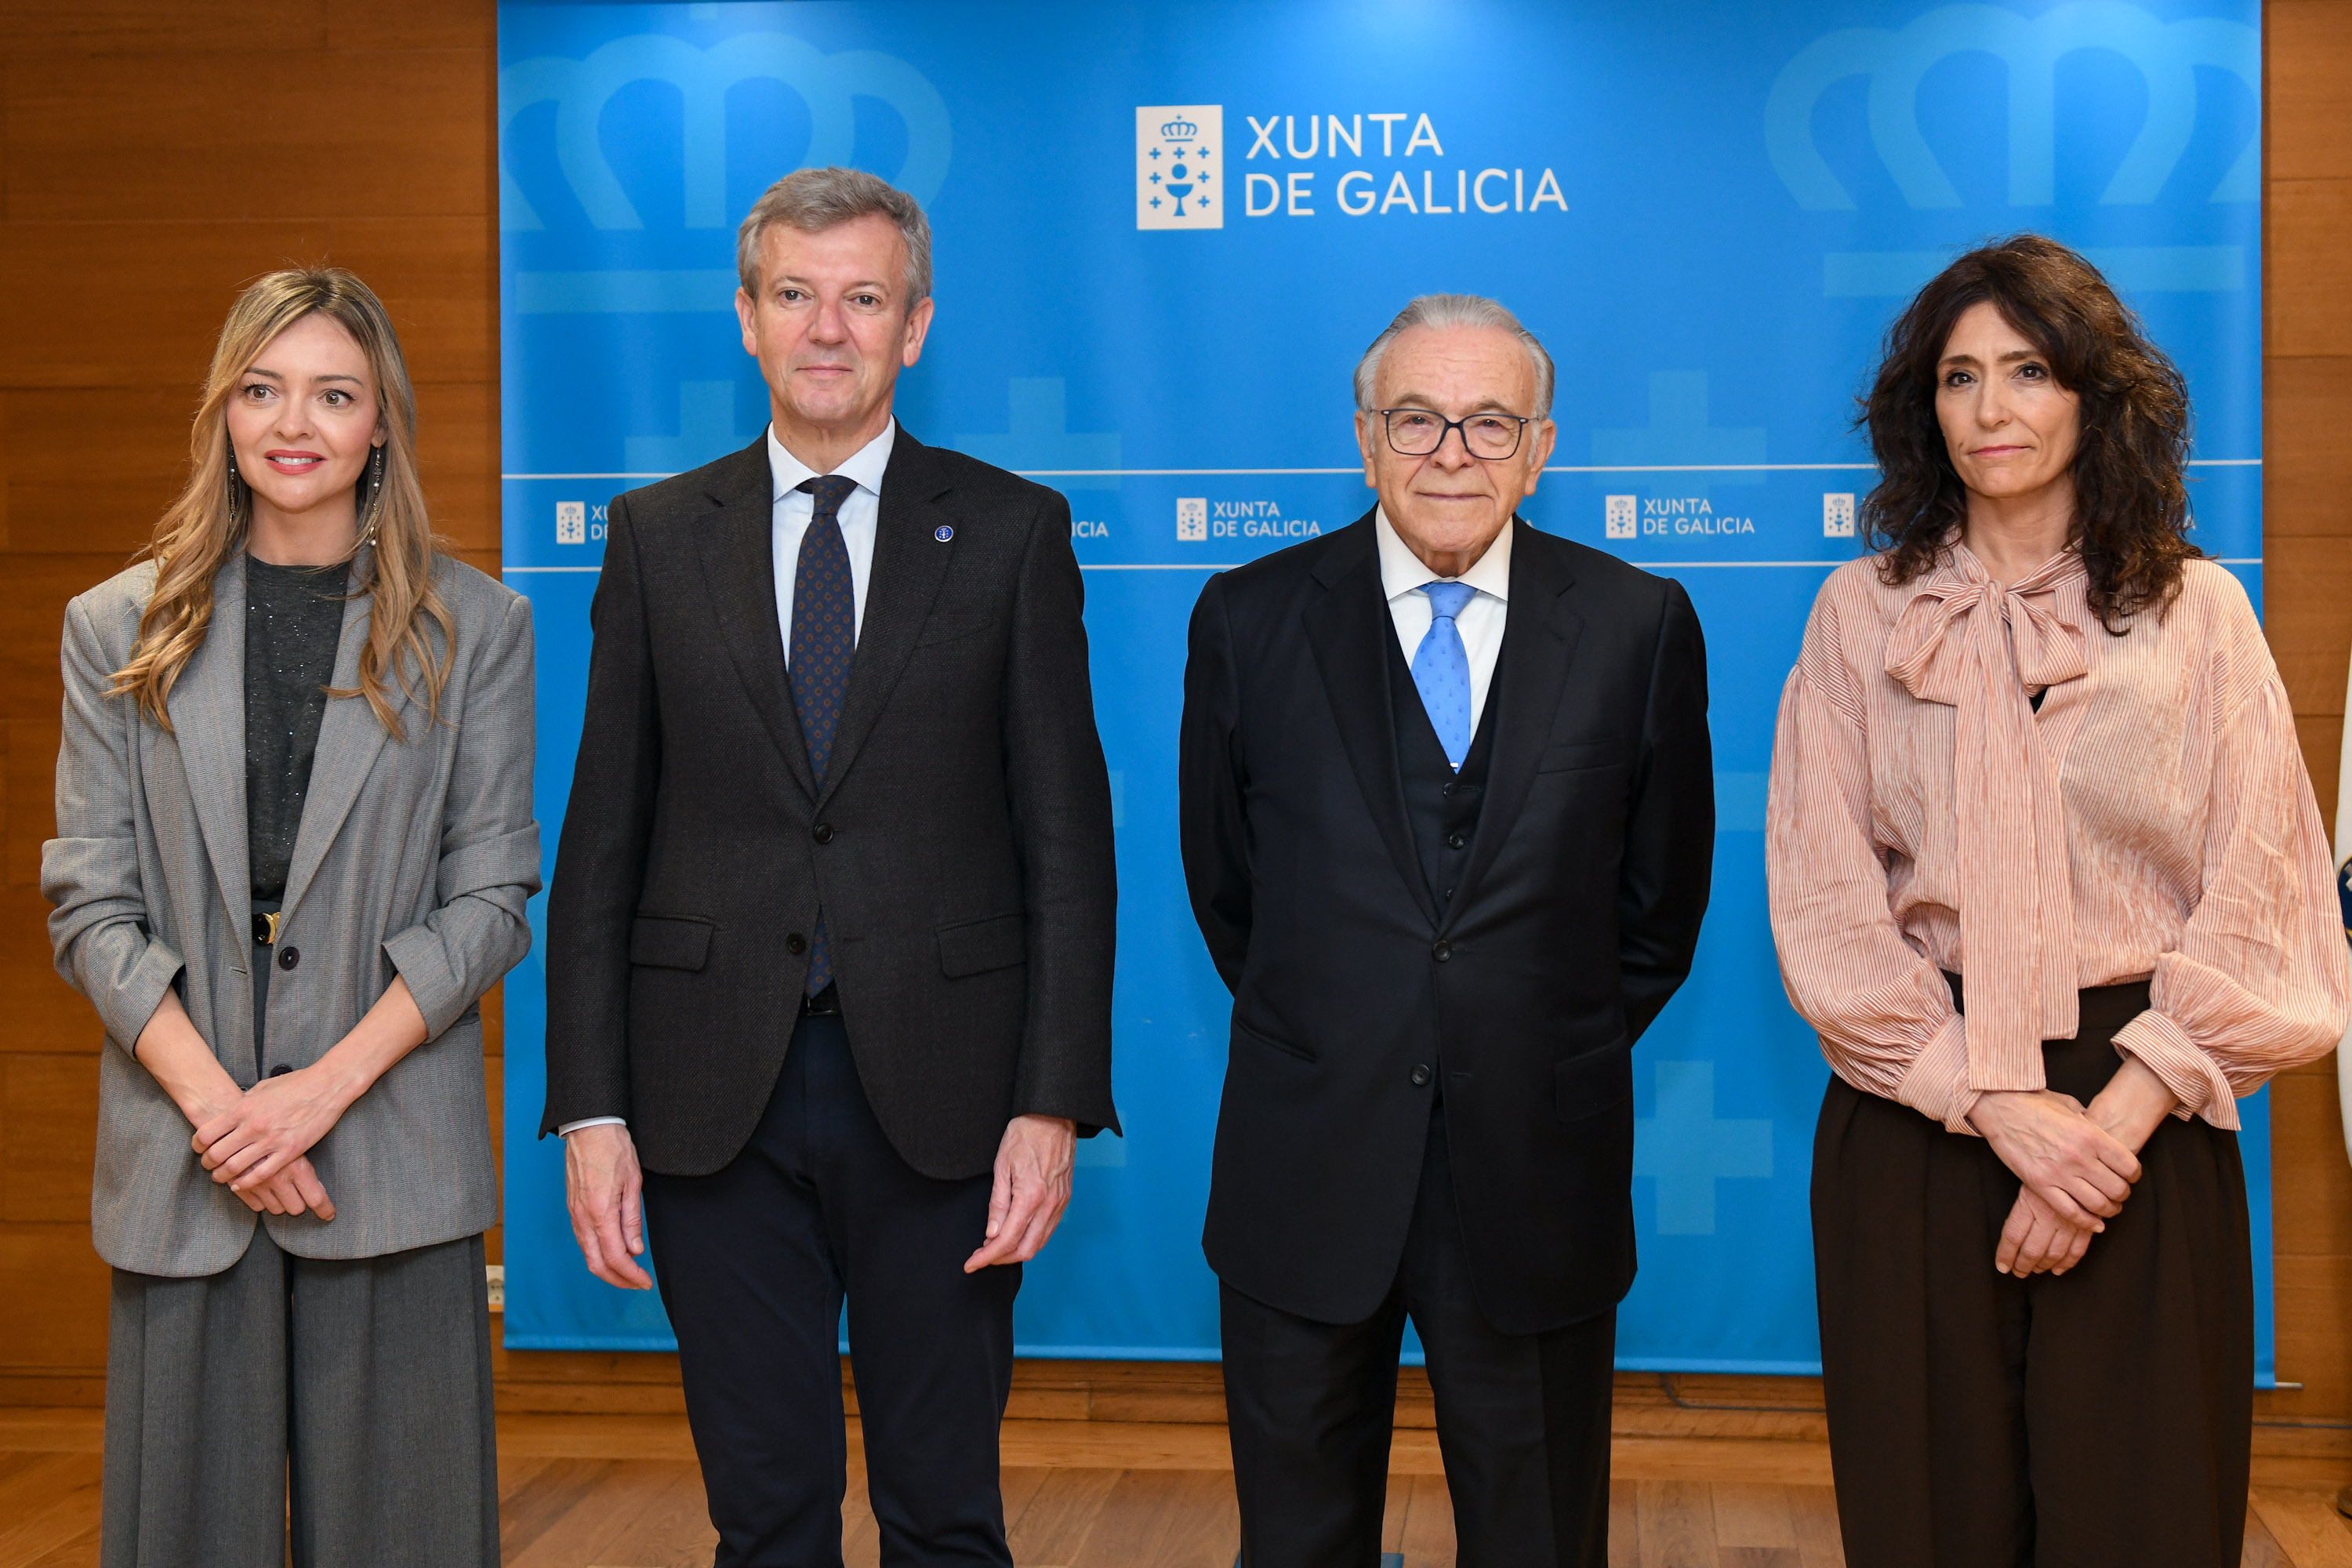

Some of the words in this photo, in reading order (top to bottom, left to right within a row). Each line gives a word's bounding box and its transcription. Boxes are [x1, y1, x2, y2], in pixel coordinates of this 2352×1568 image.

[1245, 112, 1445, 160] XUNTA
[1245, 172, 1316, 217] DE
[1336, 168, 1569, 216] GALICIA
[1214, 501, 1281, 517] XUNTA
[1643, 498, 1712, 515] XUNTA
[1072, 521, 1109, 538] ICIA
[1213, 521, 1238, 537] DE
[1243, 520, 1322, 537] GALICIA
[1643, 517, 1668, 535] DE
[1675, 517, 1755, 535] GALICIA
